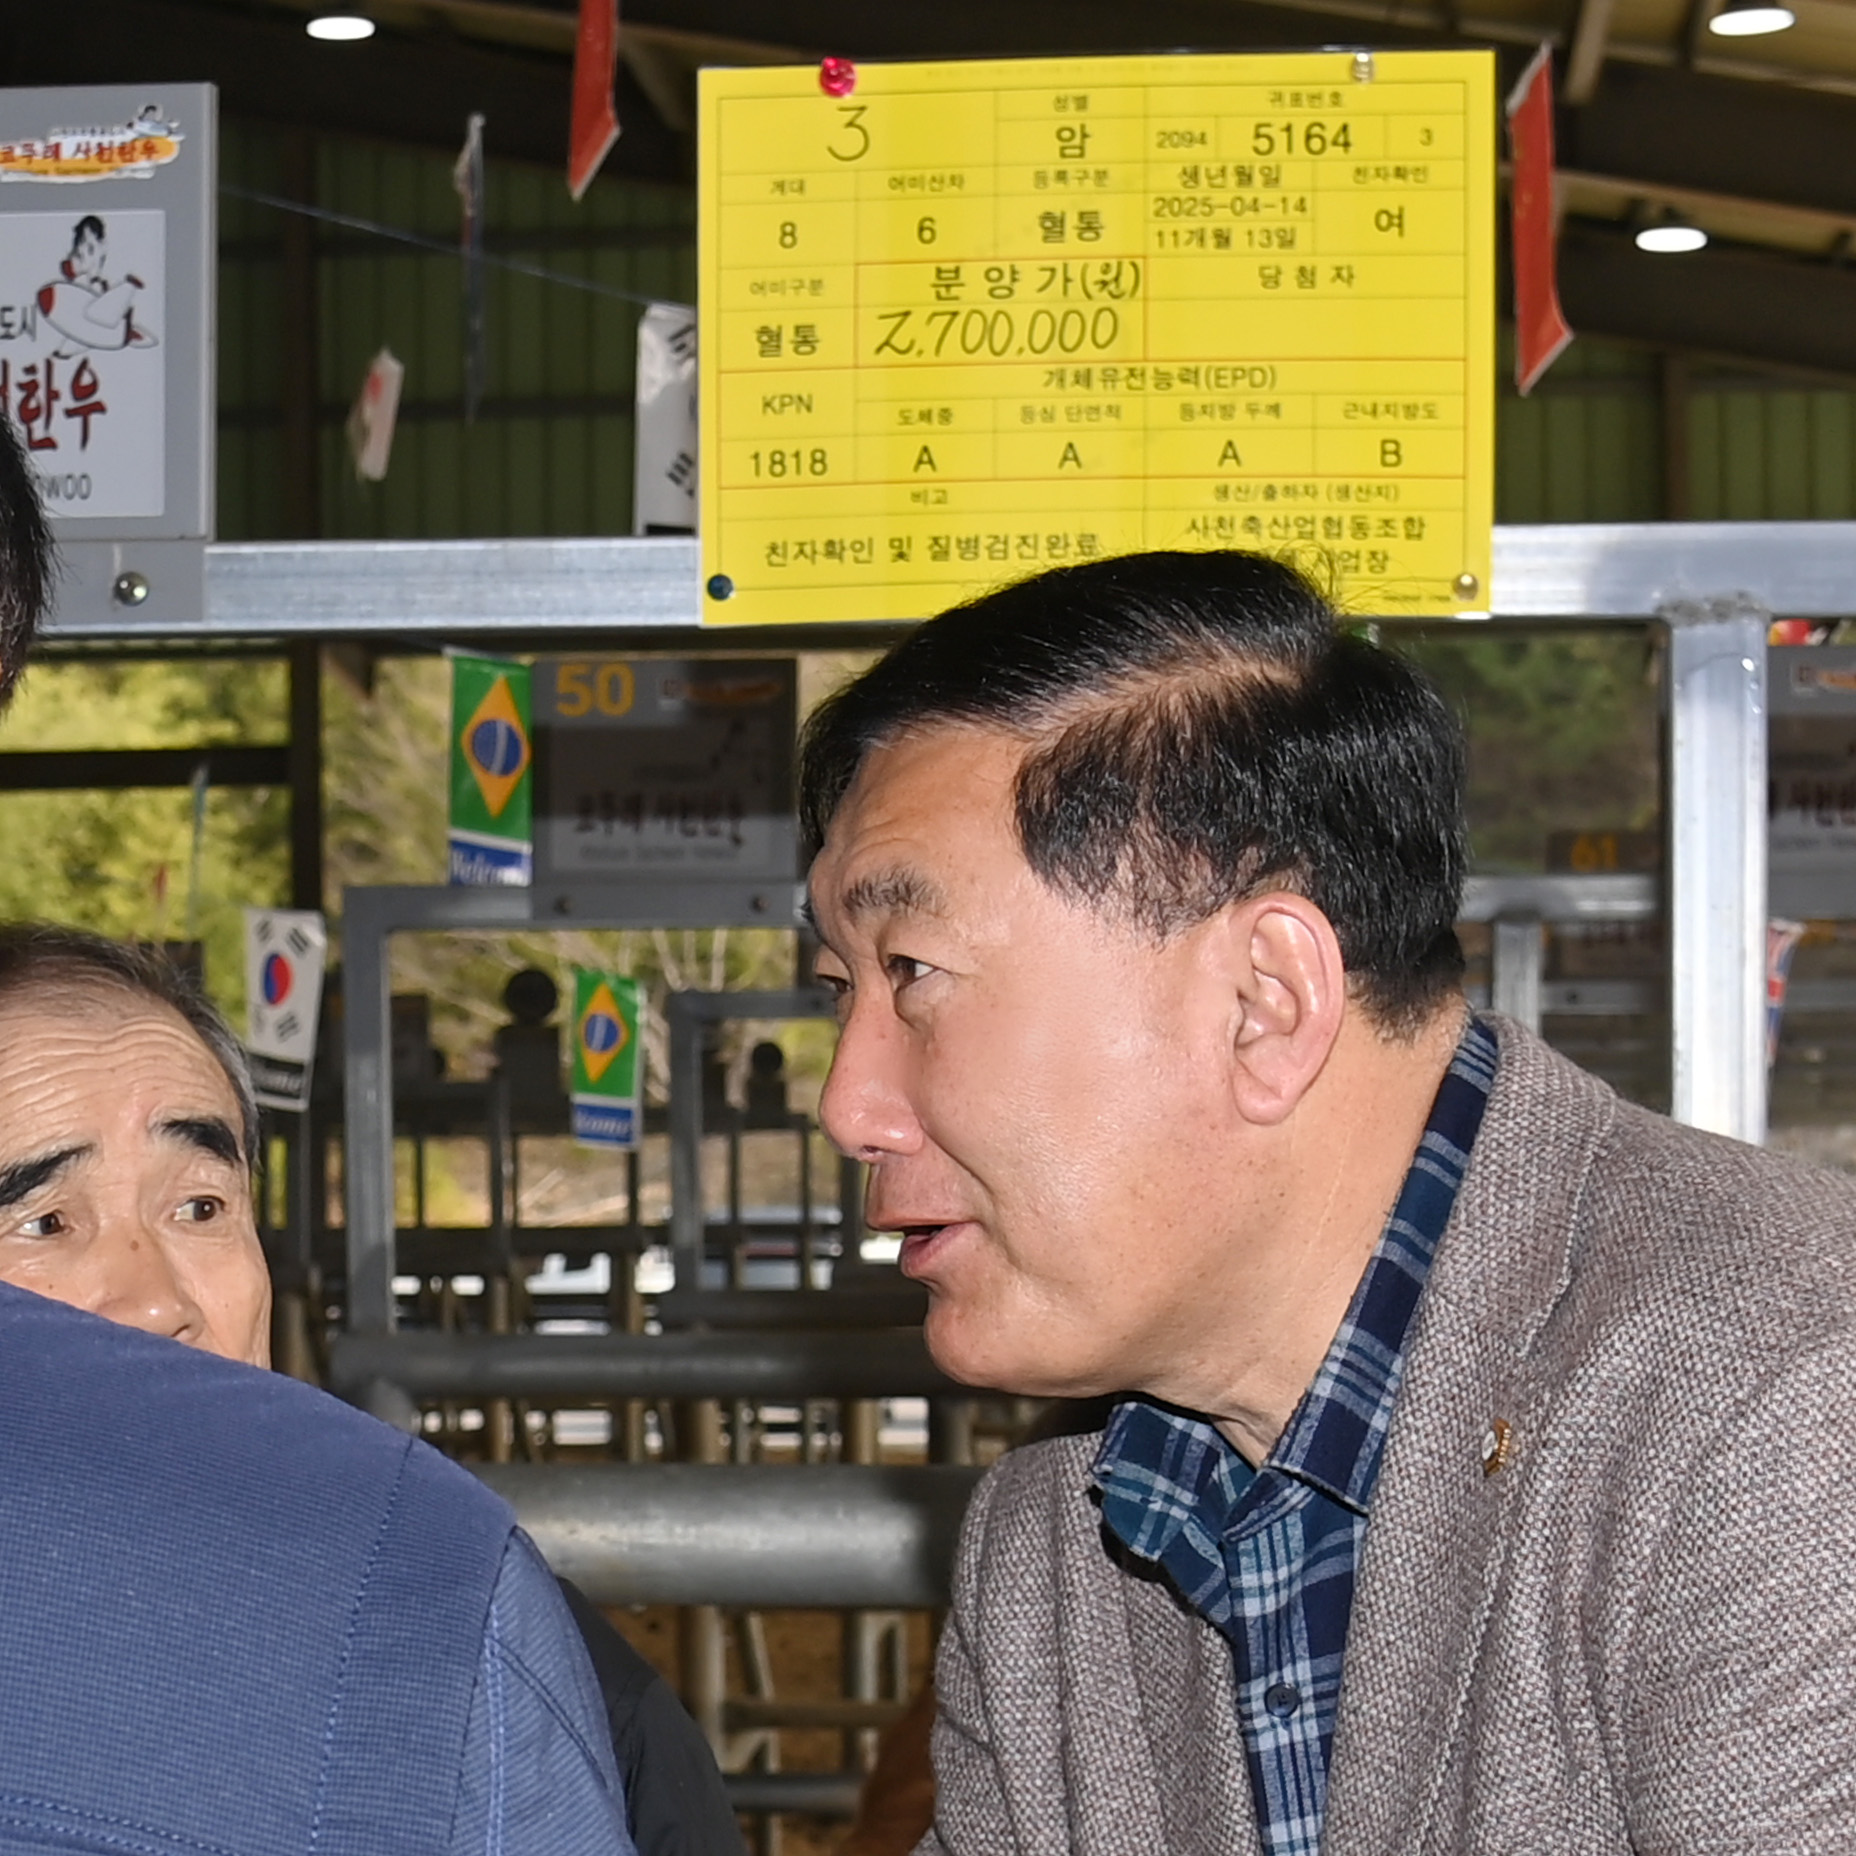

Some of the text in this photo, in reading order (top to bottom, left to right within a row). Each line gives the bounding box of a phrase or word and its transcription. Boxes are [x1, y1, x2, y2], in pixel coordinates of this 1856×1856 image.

[827, 105, 870, 161] 3
[1055, 124, 1091, 159] 암
[1156, 122, 1433, 156] 2094 5164 3
[1179, 164, 1281, 188] 생년월일
[1153, 197, 1307, 217] 2025-04-14
[778, 222, 798, 249] 8
[917, 217, 937, 244] 6
[1374, 206, 1405, 237] 여
[1157, 227, 1296, 249] 11개월 13일
[1043, 364, 1277, 392] 개체유전능력(EPD)
[762, 394, 813, 415] KPN
[749, 439, 1403, 478] 1818 A A A B
[1186, 515, 1426, 542] 사천축산업협동조합
[764, 532, 1101, 567] 친자확인 및 질병검진완료
[555, 662, 637, 718] 50
